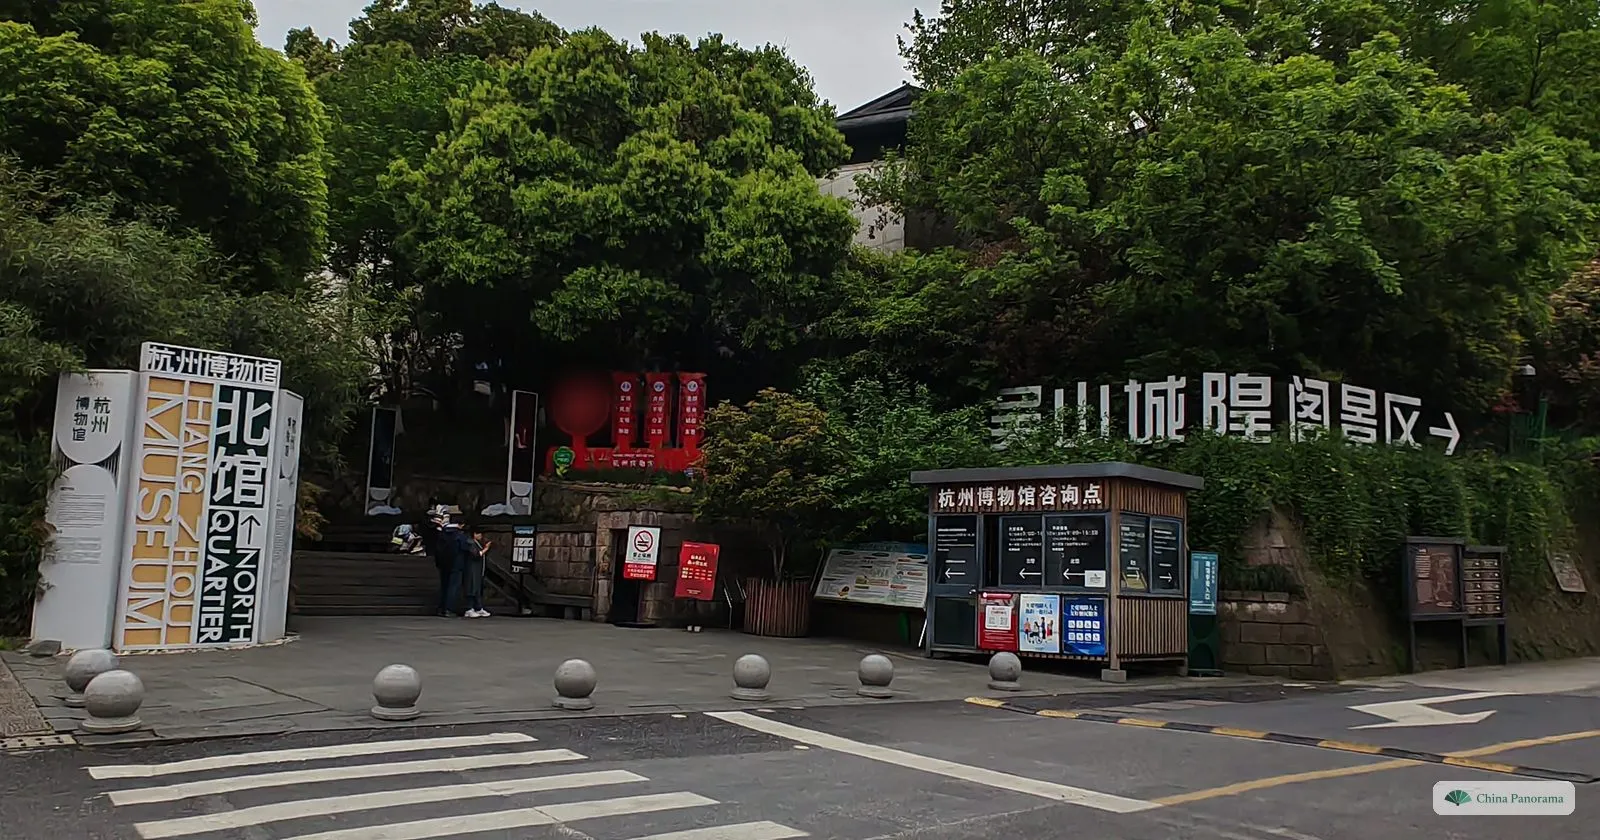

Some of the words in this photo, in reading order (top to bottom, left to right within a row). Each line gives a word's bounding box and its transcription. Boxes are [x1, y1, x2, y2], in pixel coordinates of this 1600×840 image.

[146, 345, 278, 383] 杭州博物馆
[72, 395, 90, 442] 博物馆
[91, 396, 112, 434] 杭州
[212, 389, 271, 505] 北馆
[124, 392, 185, 629] MUSEUM
[938, 483, 1102, 508] 杭州博物馆咨询点
[199, 510, 236, 643] QUARTIER
[229, 549, 259, 642] NORTH
